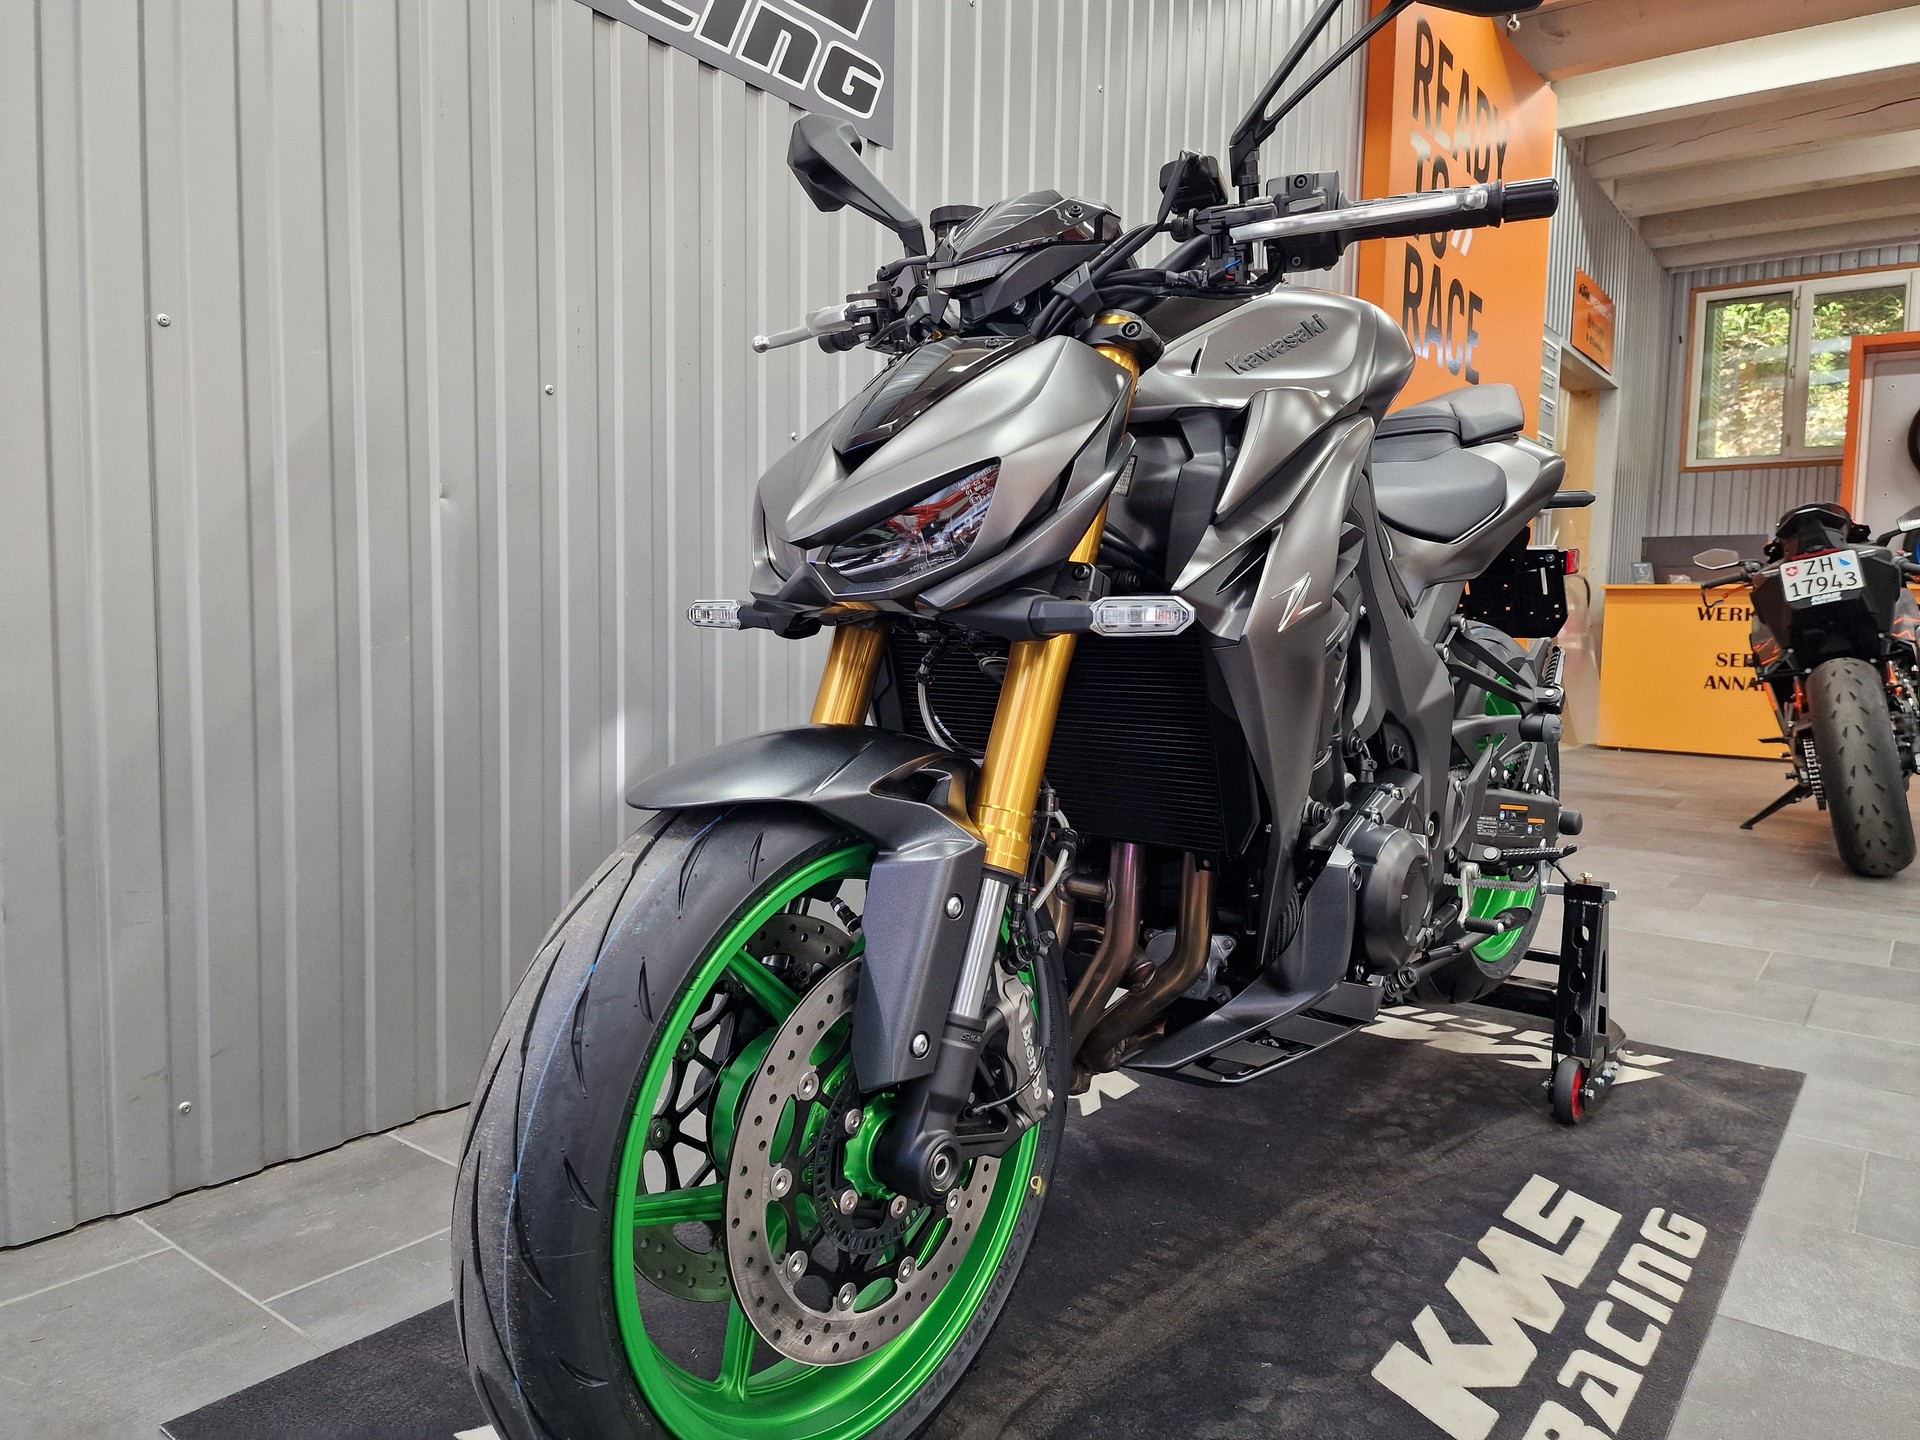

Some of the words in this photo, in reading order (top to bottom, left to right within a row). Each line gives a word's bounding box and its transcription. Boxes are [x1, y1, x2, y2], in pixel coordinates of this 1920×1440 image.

[1412, 17, 1509, 187] READY
[1225, 313, 1328, 375] Kawasaki
[1402, 241, 1483, 386] RACE
[1789, 571, 1858, 598] 17943
[1803, 557, 1834, 576] ZH
[1703, 675, 1765, 691] ANNA
[1371, 1174, 1623, 1440] KMS
